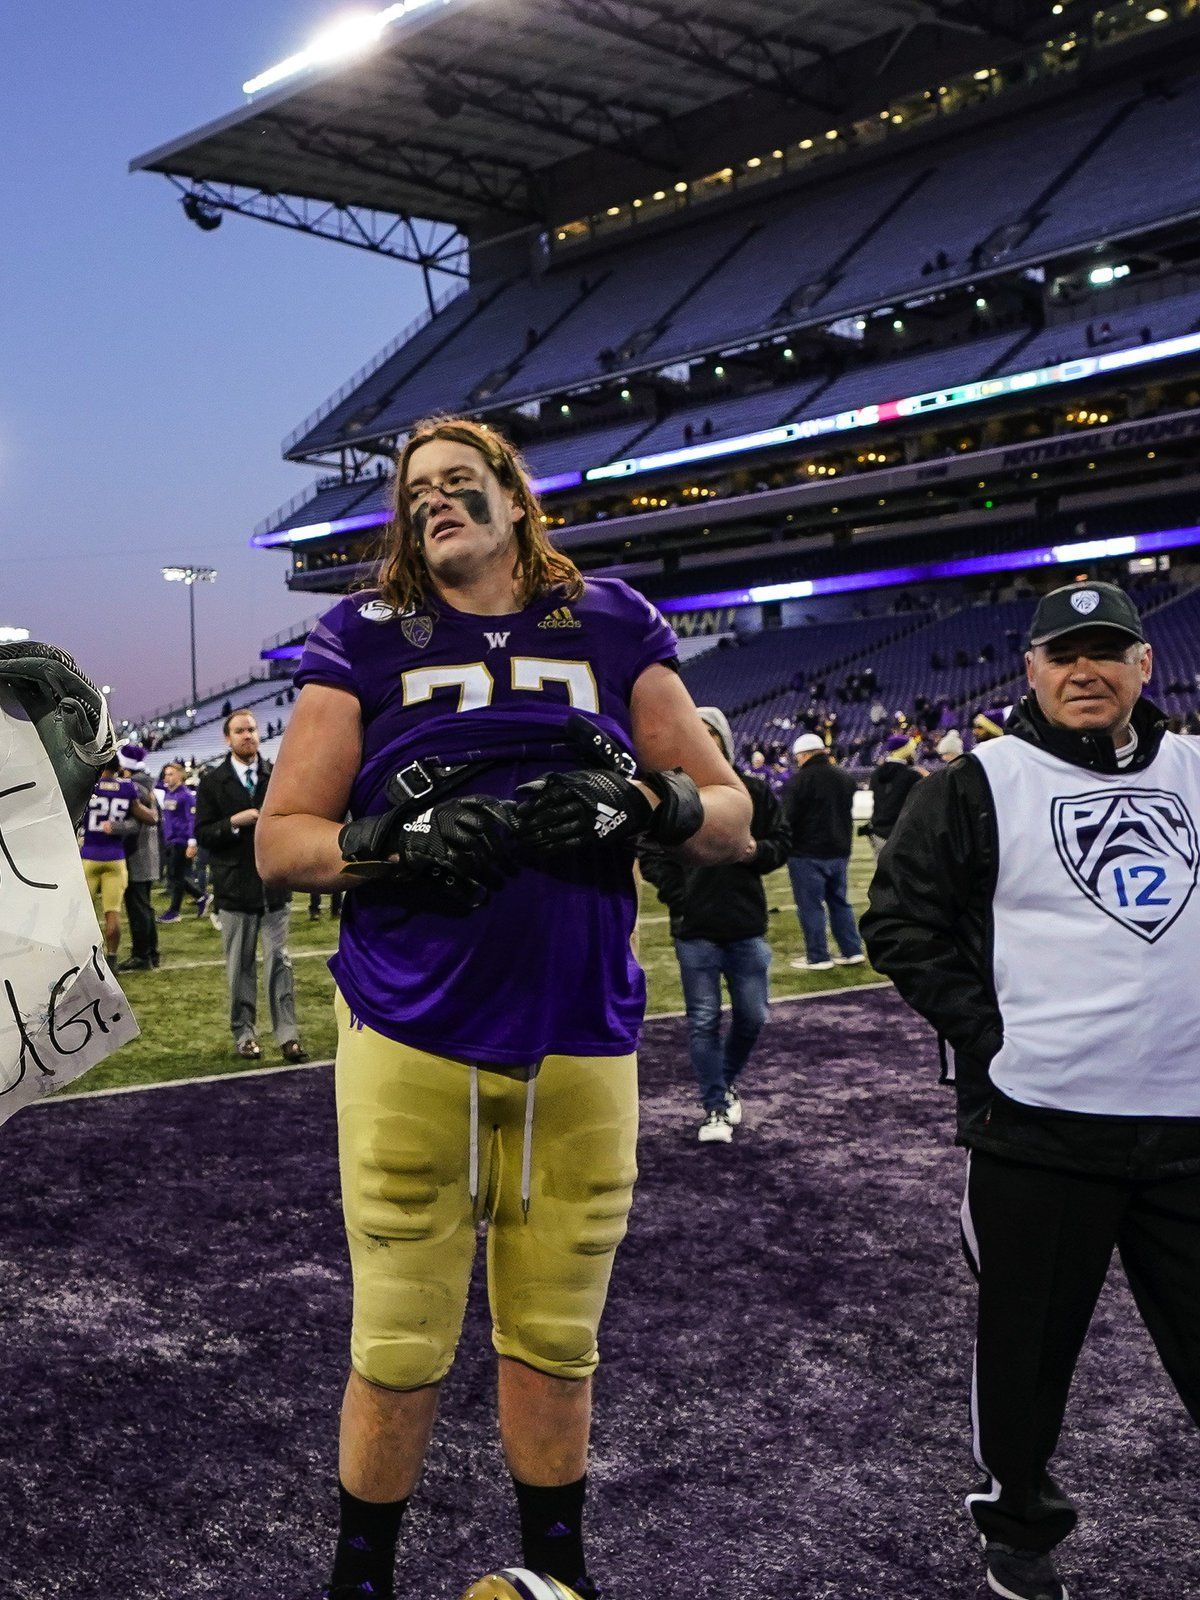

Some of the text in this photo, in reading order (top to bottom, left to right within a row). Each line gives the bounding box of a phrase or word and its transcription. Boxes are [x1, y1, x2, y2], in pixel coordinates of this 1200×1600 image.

[483, 631, 511, 650] W
[1061, 796, 1192, 882] PAC
[1113, 865, 1172, 907] 12
